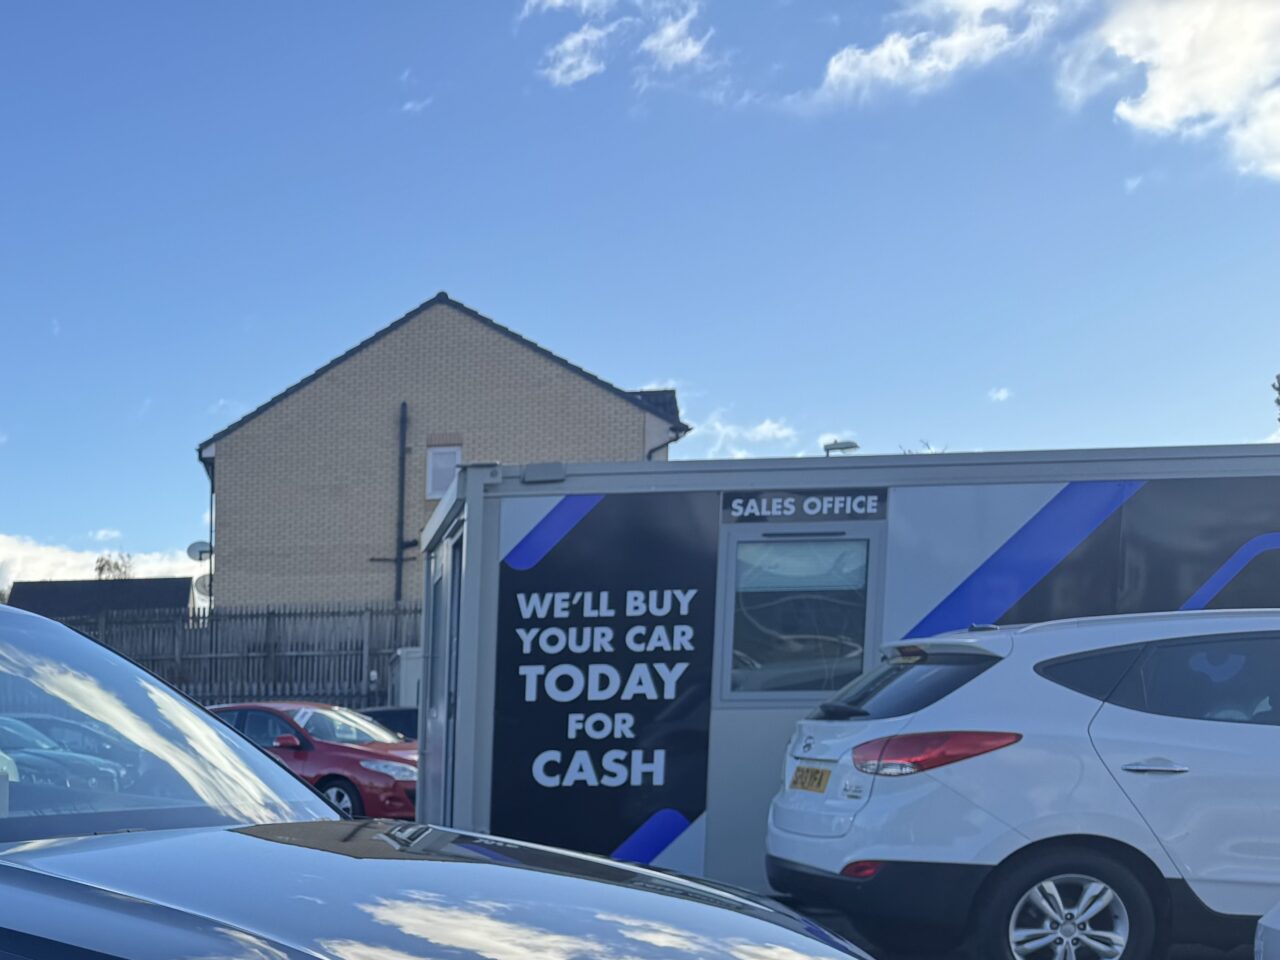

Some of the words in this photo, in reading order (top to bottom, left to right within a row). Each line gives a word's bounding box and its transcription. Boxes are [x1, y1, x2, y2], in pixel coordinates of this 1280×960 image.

[730, 497, 796, 517] SALES
[802, 495, 878, 516] OFFICE
[625, 589, 698, 617] BUY
[516, 627, 614, 655] YOUR
[624, 625, 695, 652] CAR
[518, 661, 690, 702] TODAY
[567, 712, 636, 740] FOR
[531, 748, 666, 788] CASH
